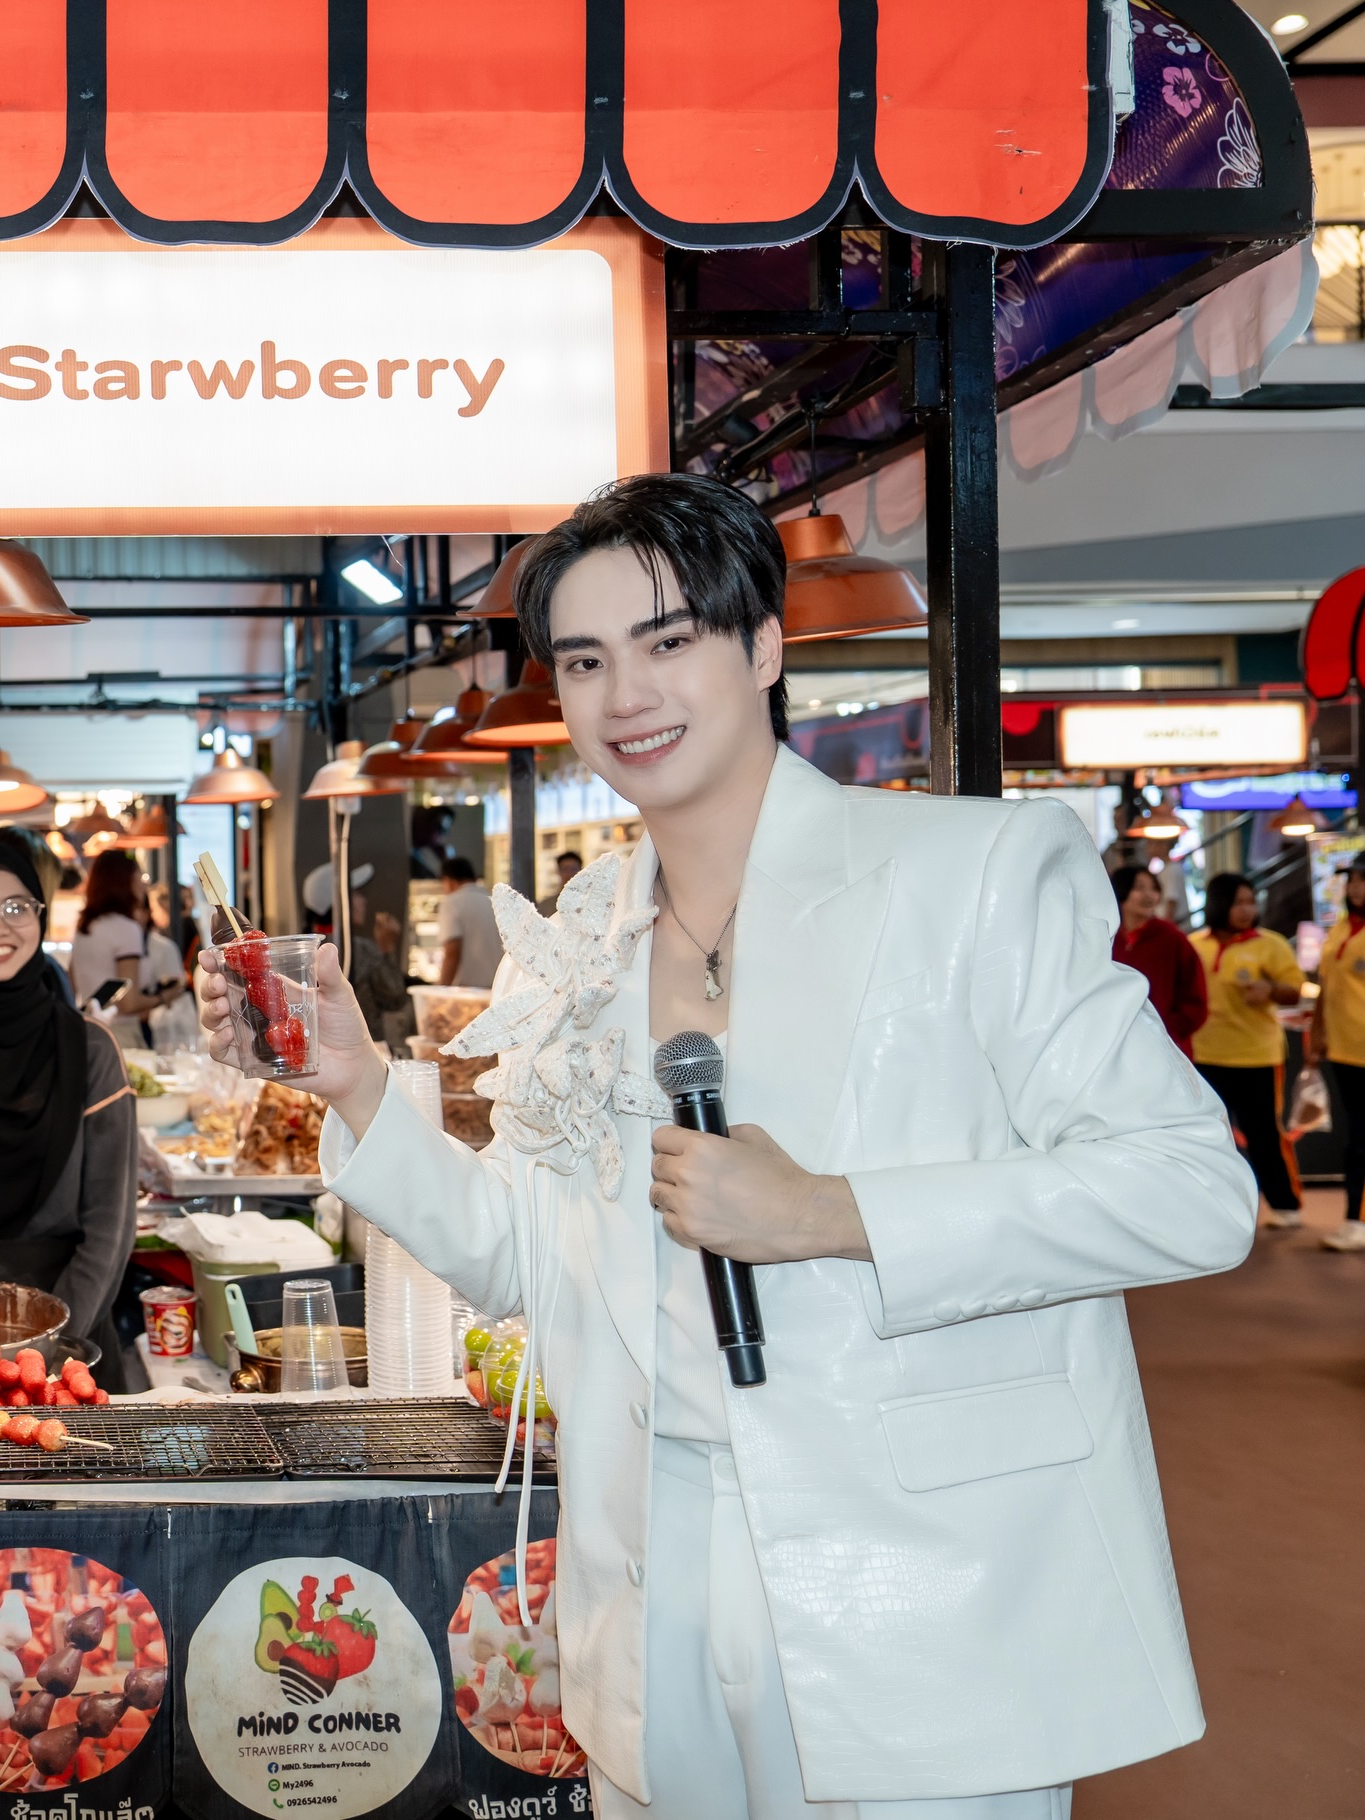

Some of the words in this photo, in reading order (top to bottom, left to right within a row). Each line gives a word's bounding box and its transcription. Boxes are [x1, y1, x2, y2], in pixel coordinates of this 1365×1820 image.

[308, 1711, 402, 1734] CONNER
[238, 1743, 315, 1758] STRAWBERRY
[318, 1743, 327, 1753] &
[330, 1740, 389, 1753] AVOCADO
[302, 1762, 340, 1770] Strawberry
[341, 1761, 371, 1769] Avocado
[282, 1780, 314, 1790] My2496
[286, 1796, 338, 1807] 0926542496
